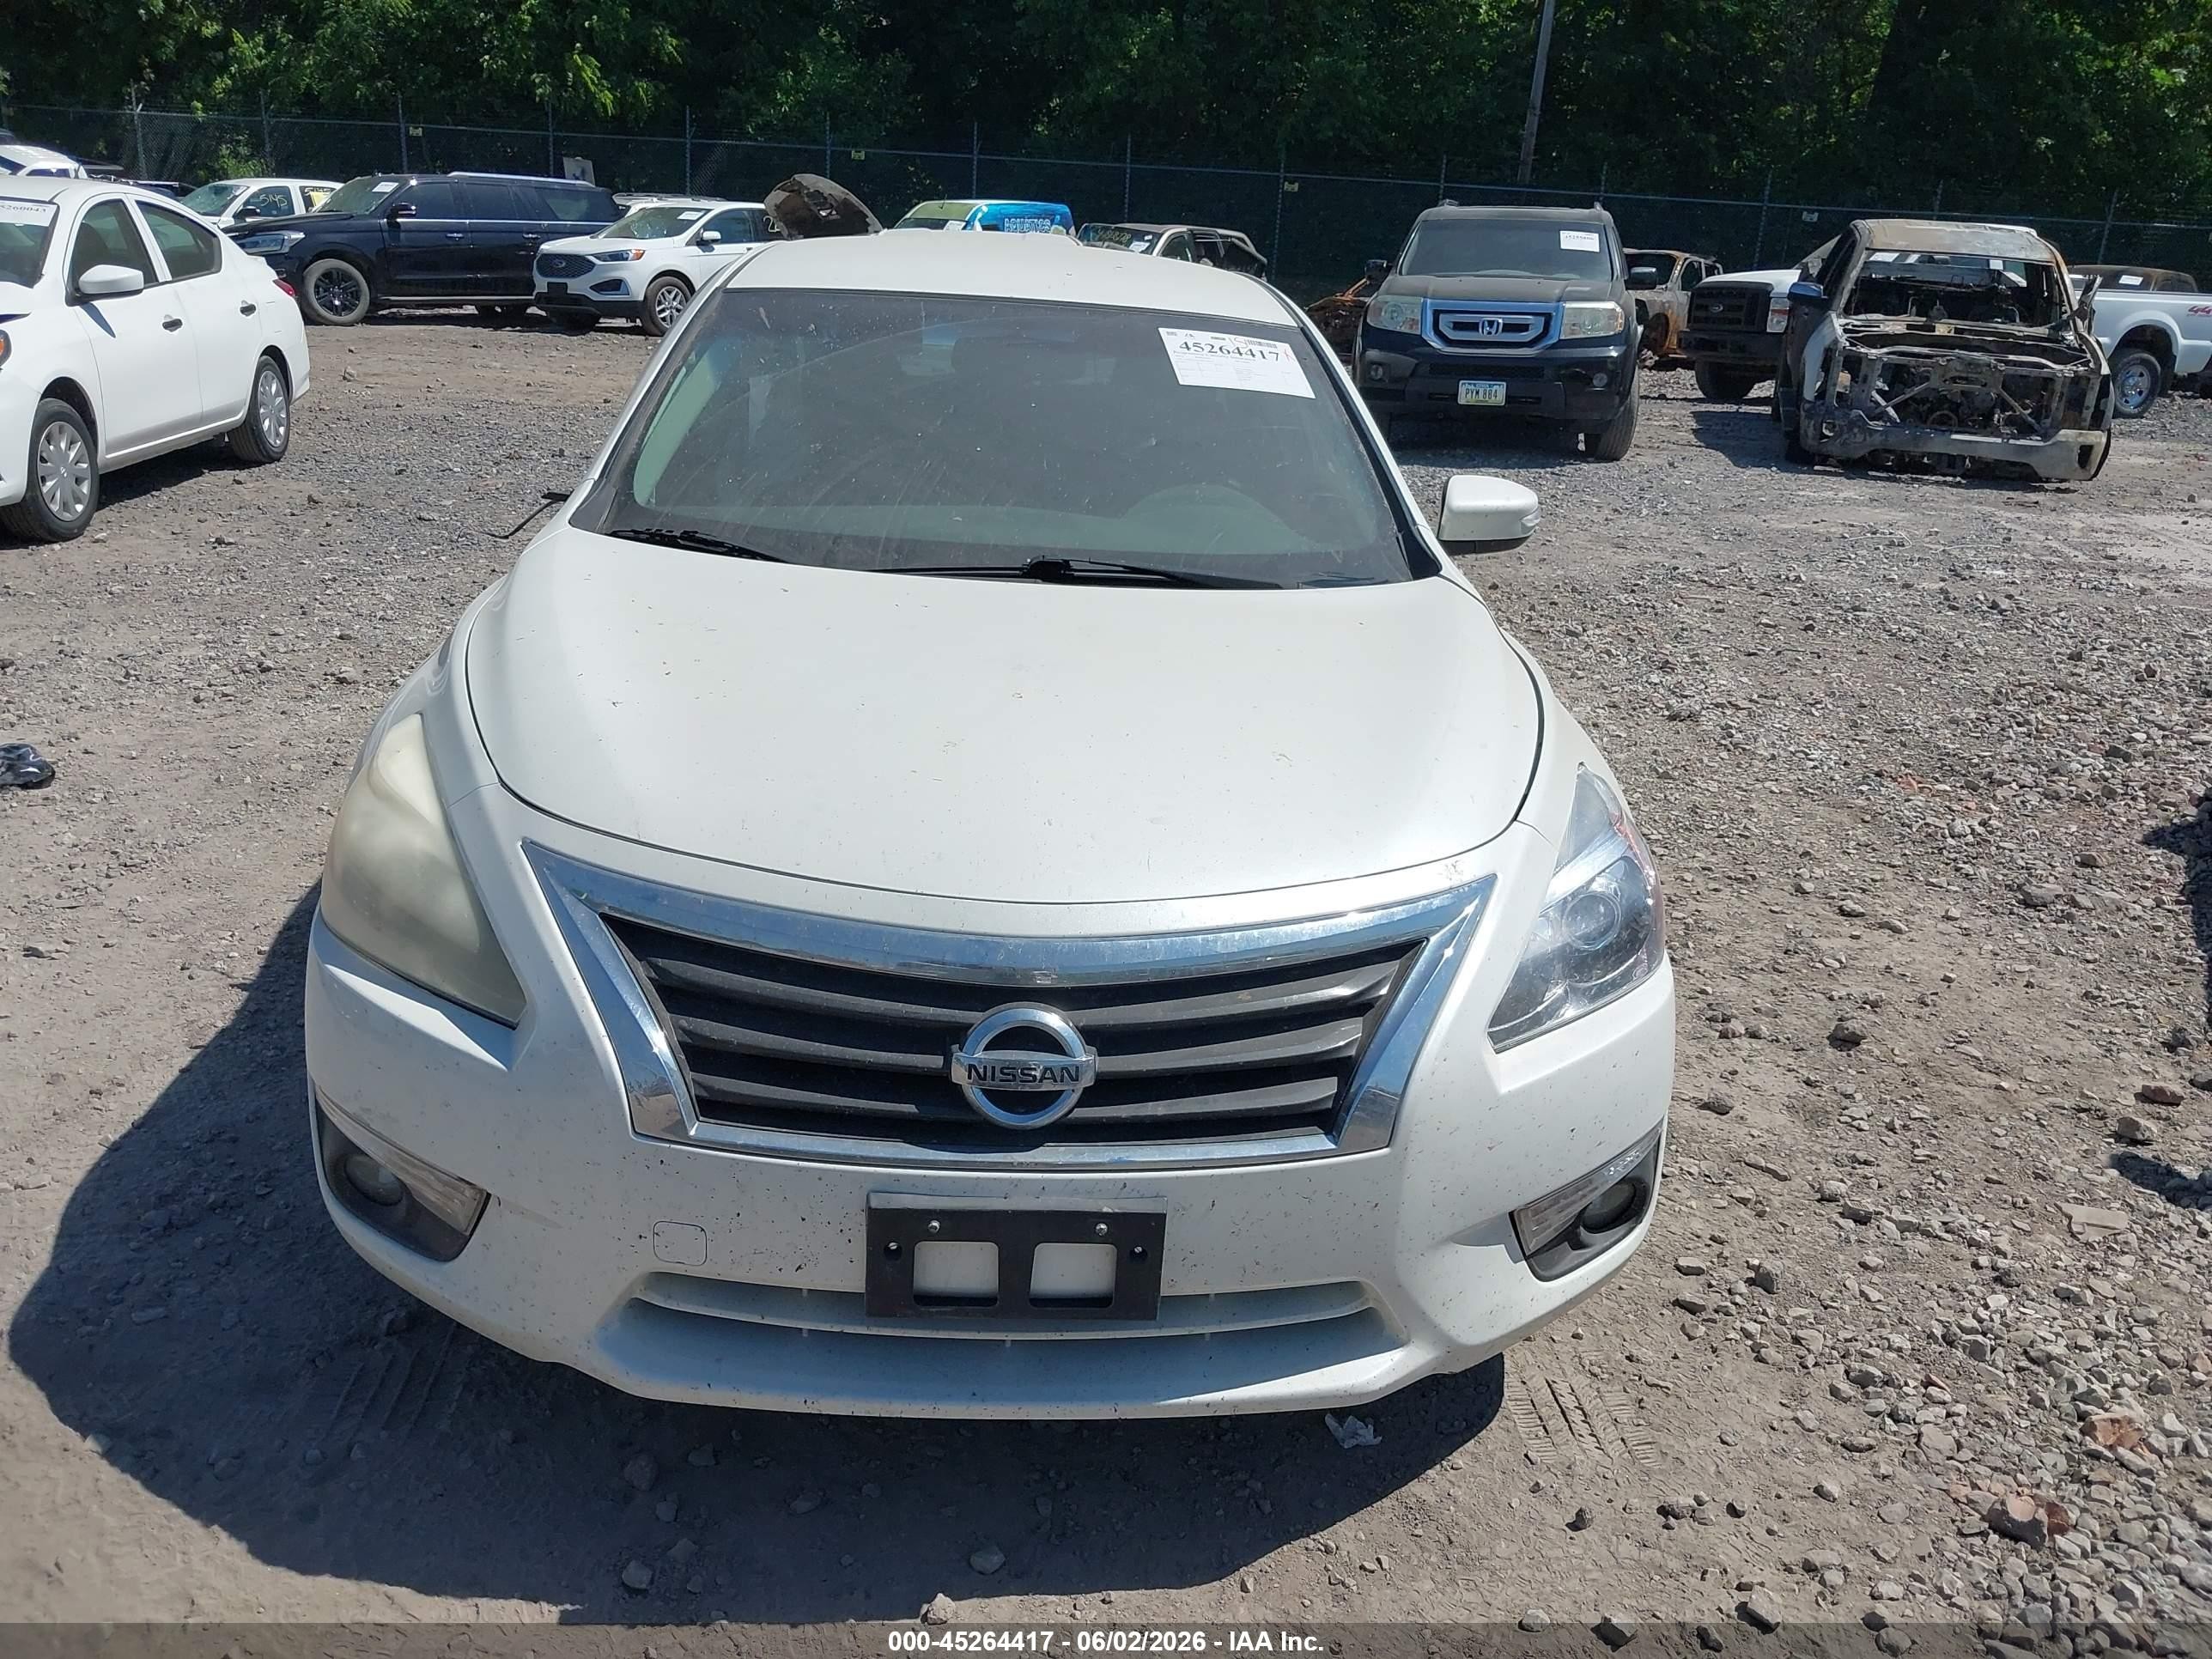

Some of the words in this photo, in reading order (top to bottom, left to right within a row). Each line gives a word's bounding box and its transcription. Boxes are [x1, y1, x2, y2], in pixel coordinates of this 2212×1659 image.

[259, 194, 288, 207] 5145
[1179, 341, 1279, 362] 45264417
[966, 1063, 1080, 1085] NISSAN
